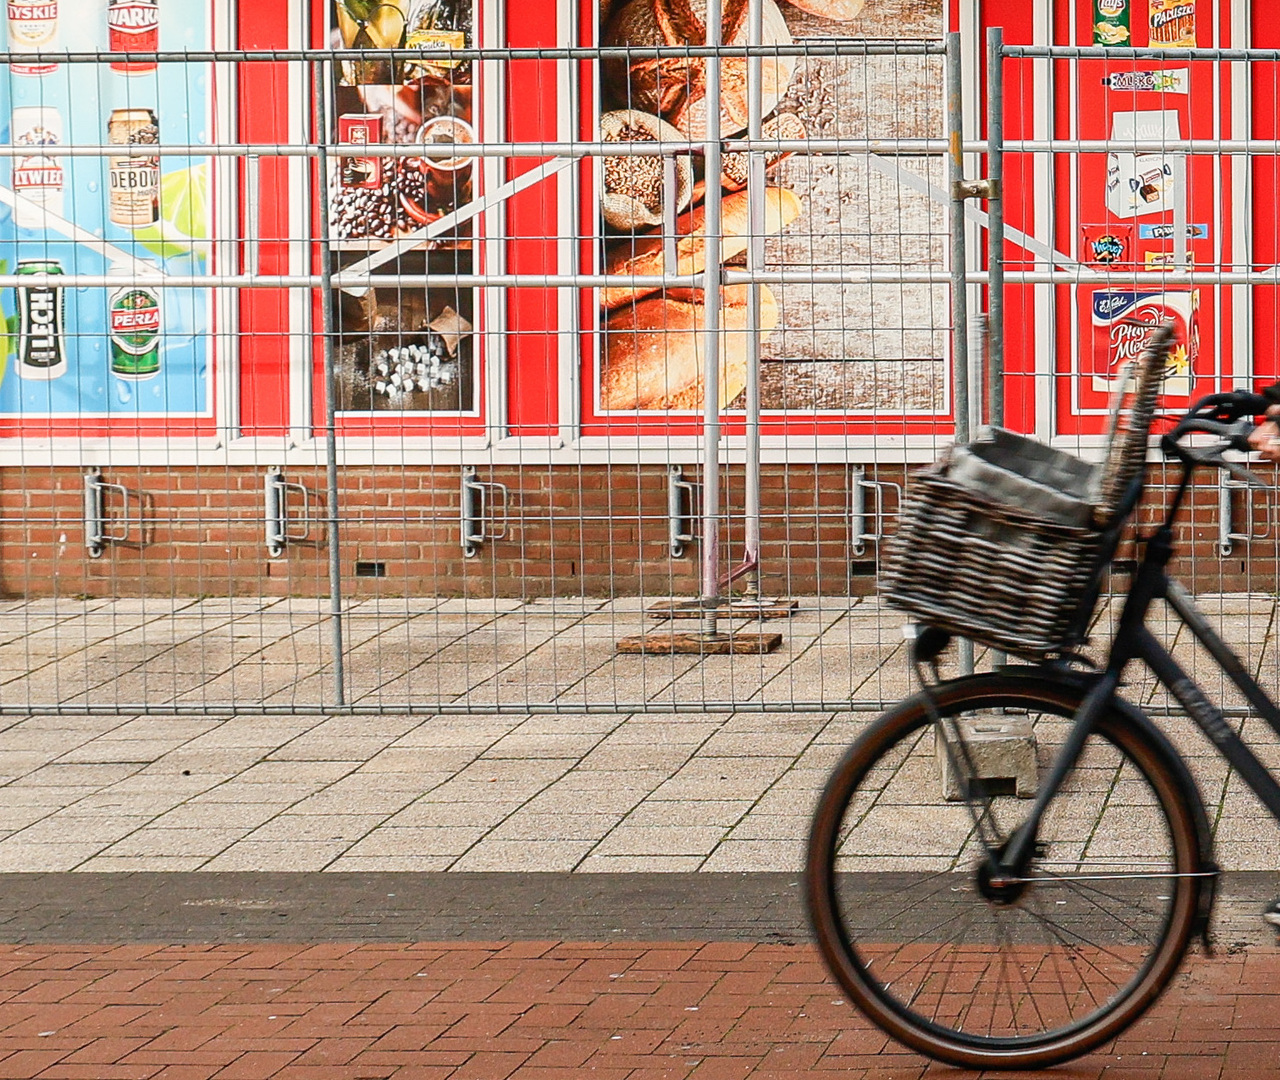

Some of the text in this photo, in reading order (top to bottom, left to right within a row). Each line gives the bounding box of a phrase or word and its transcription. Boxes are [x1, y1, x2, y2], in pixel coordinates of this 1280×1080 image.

[1153, 3, 1194, 27] PALUSZKI
[30, 293, 55, 348] LECH
[114, 311, 159, 326] PERŁA
